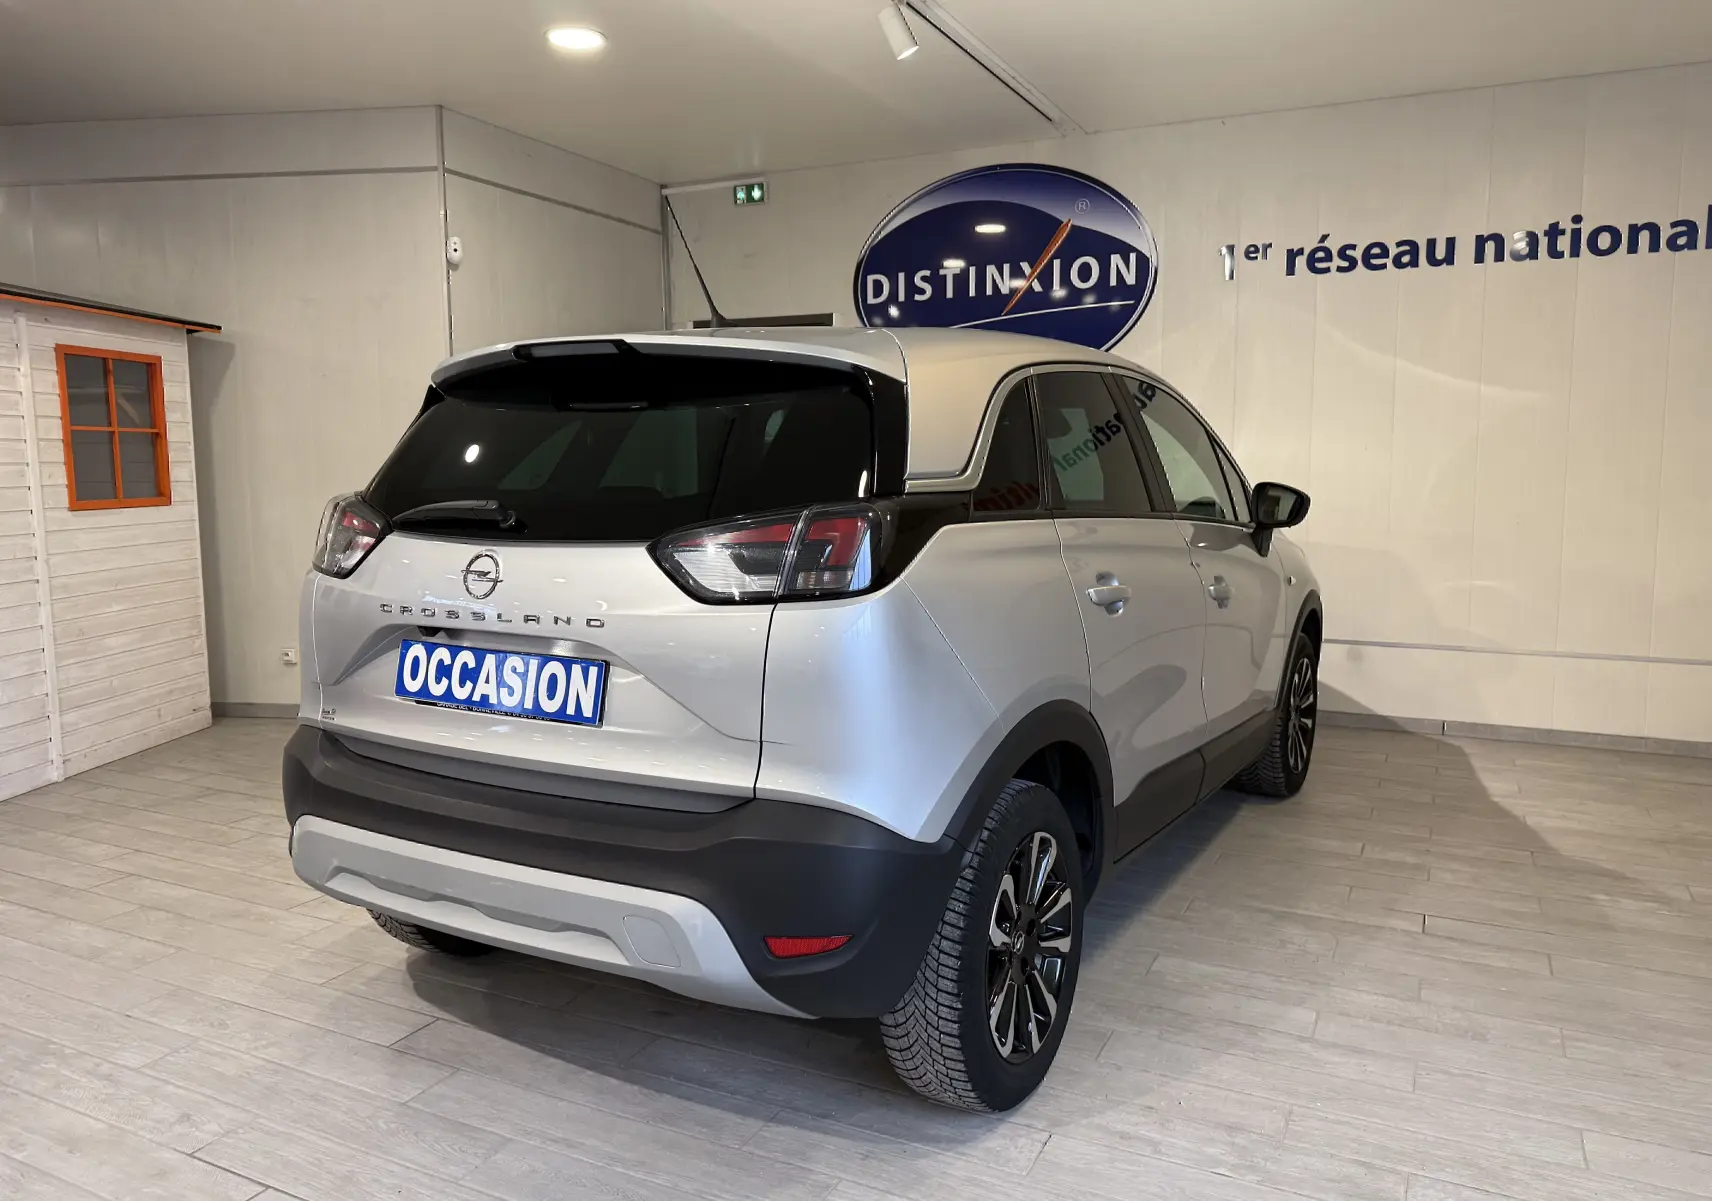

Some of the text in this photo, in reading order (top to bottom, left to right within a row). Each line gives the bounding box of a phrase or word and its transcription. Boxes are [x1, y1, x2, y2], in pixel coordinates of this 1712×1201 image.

[1219, 204, 1712, 281] 1er réseau national
[866, 252, 1137, 305] DISTINXION
[379, 603, 605, 629] CROSSLAND
[403, 643, 598, 718] OCCASION
